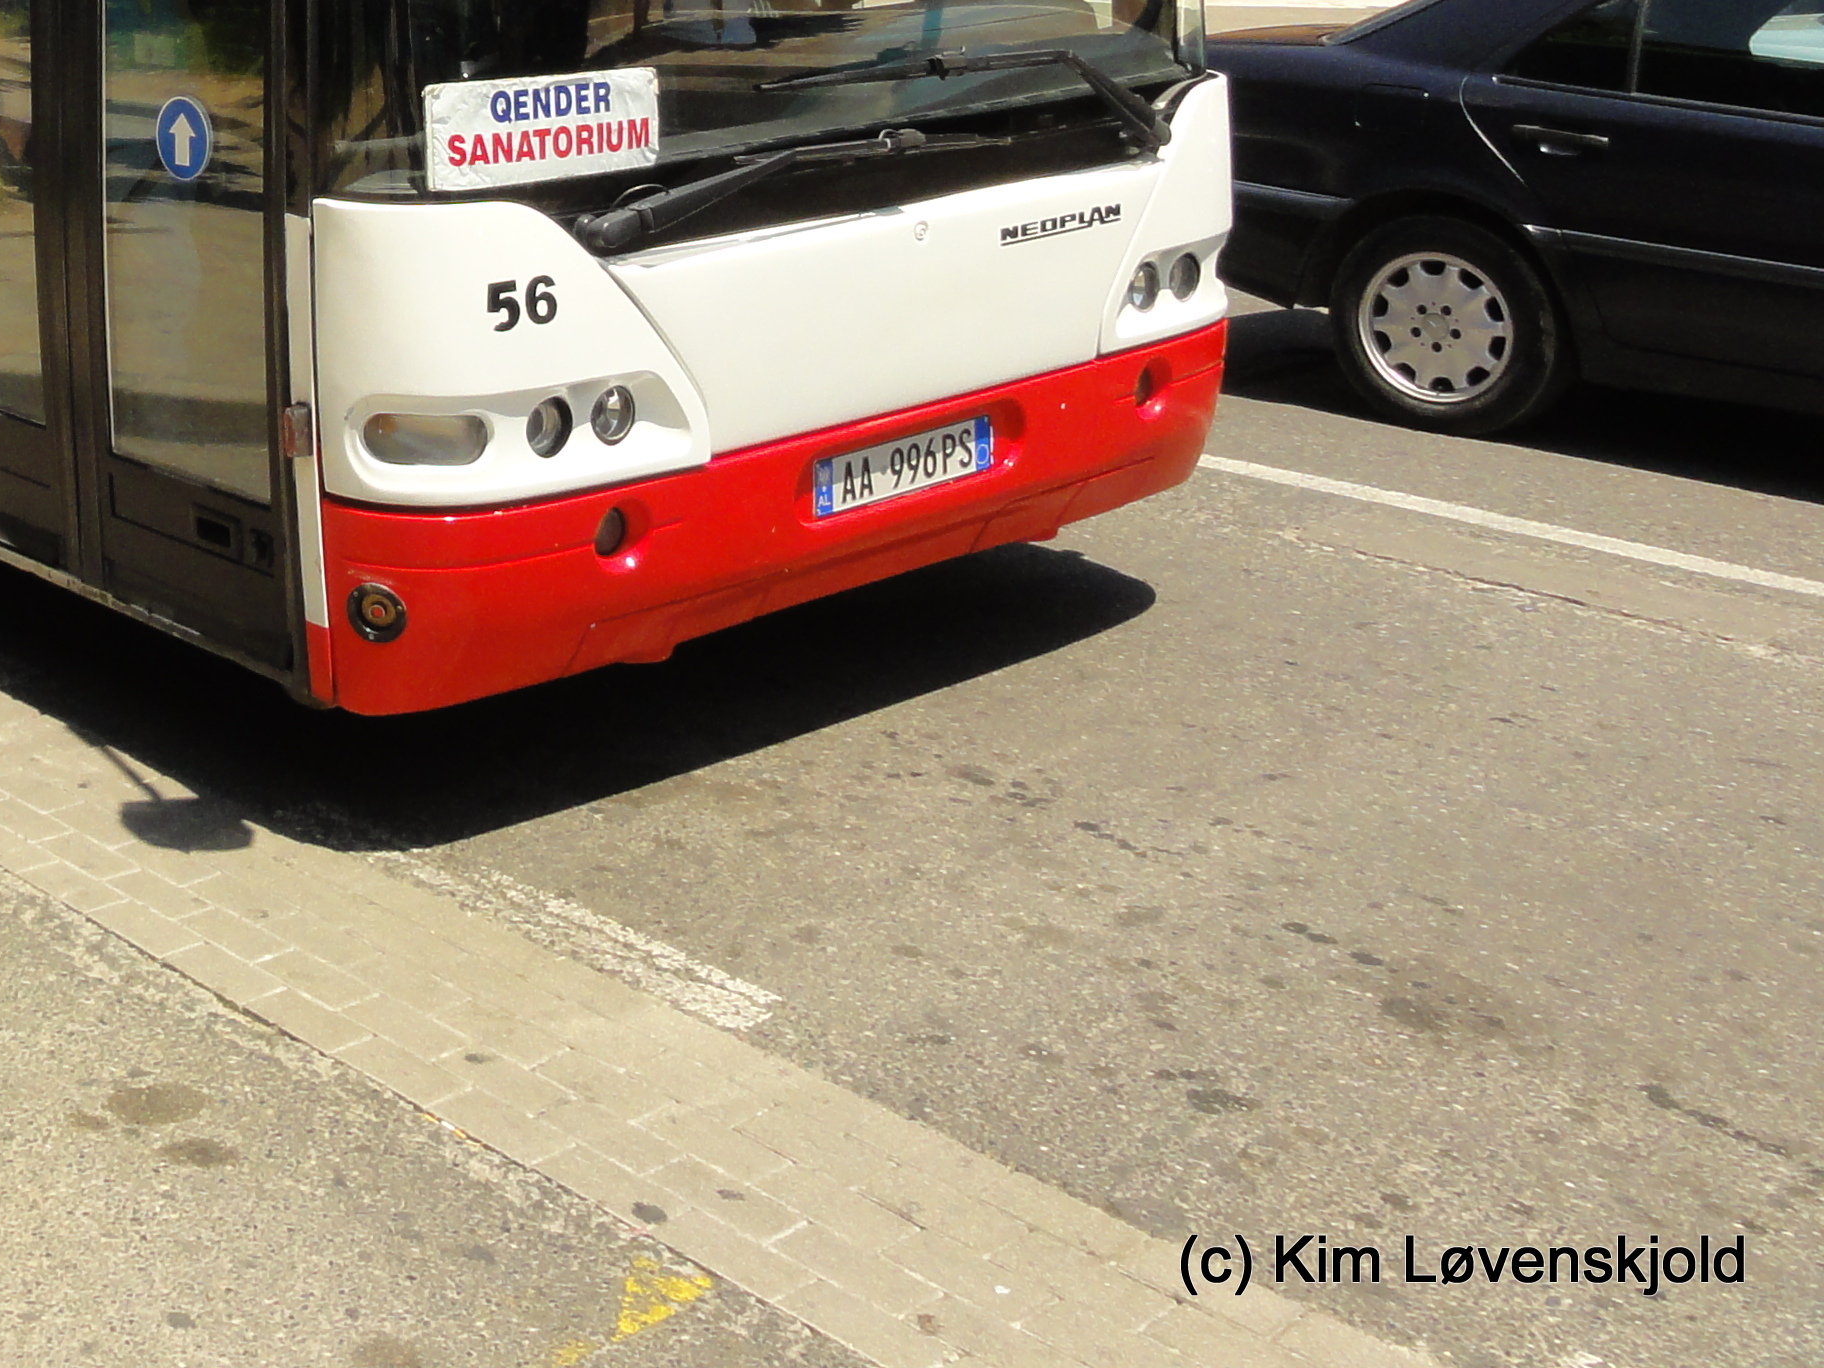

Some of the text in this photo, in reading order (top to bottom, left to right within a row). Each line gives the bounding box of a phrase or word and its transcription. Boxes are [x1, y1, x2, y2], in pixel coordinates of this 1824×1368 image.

[490, 82, 611, 124] QENDER
[447, 117, 650, 167] SANATORIUM
[1000, 203, 1121, 245] NEOPLAN
[486, 274, 558, 333] 56
[817, 494, 832, 507] AL
[841, 456, 874, 504] AA
